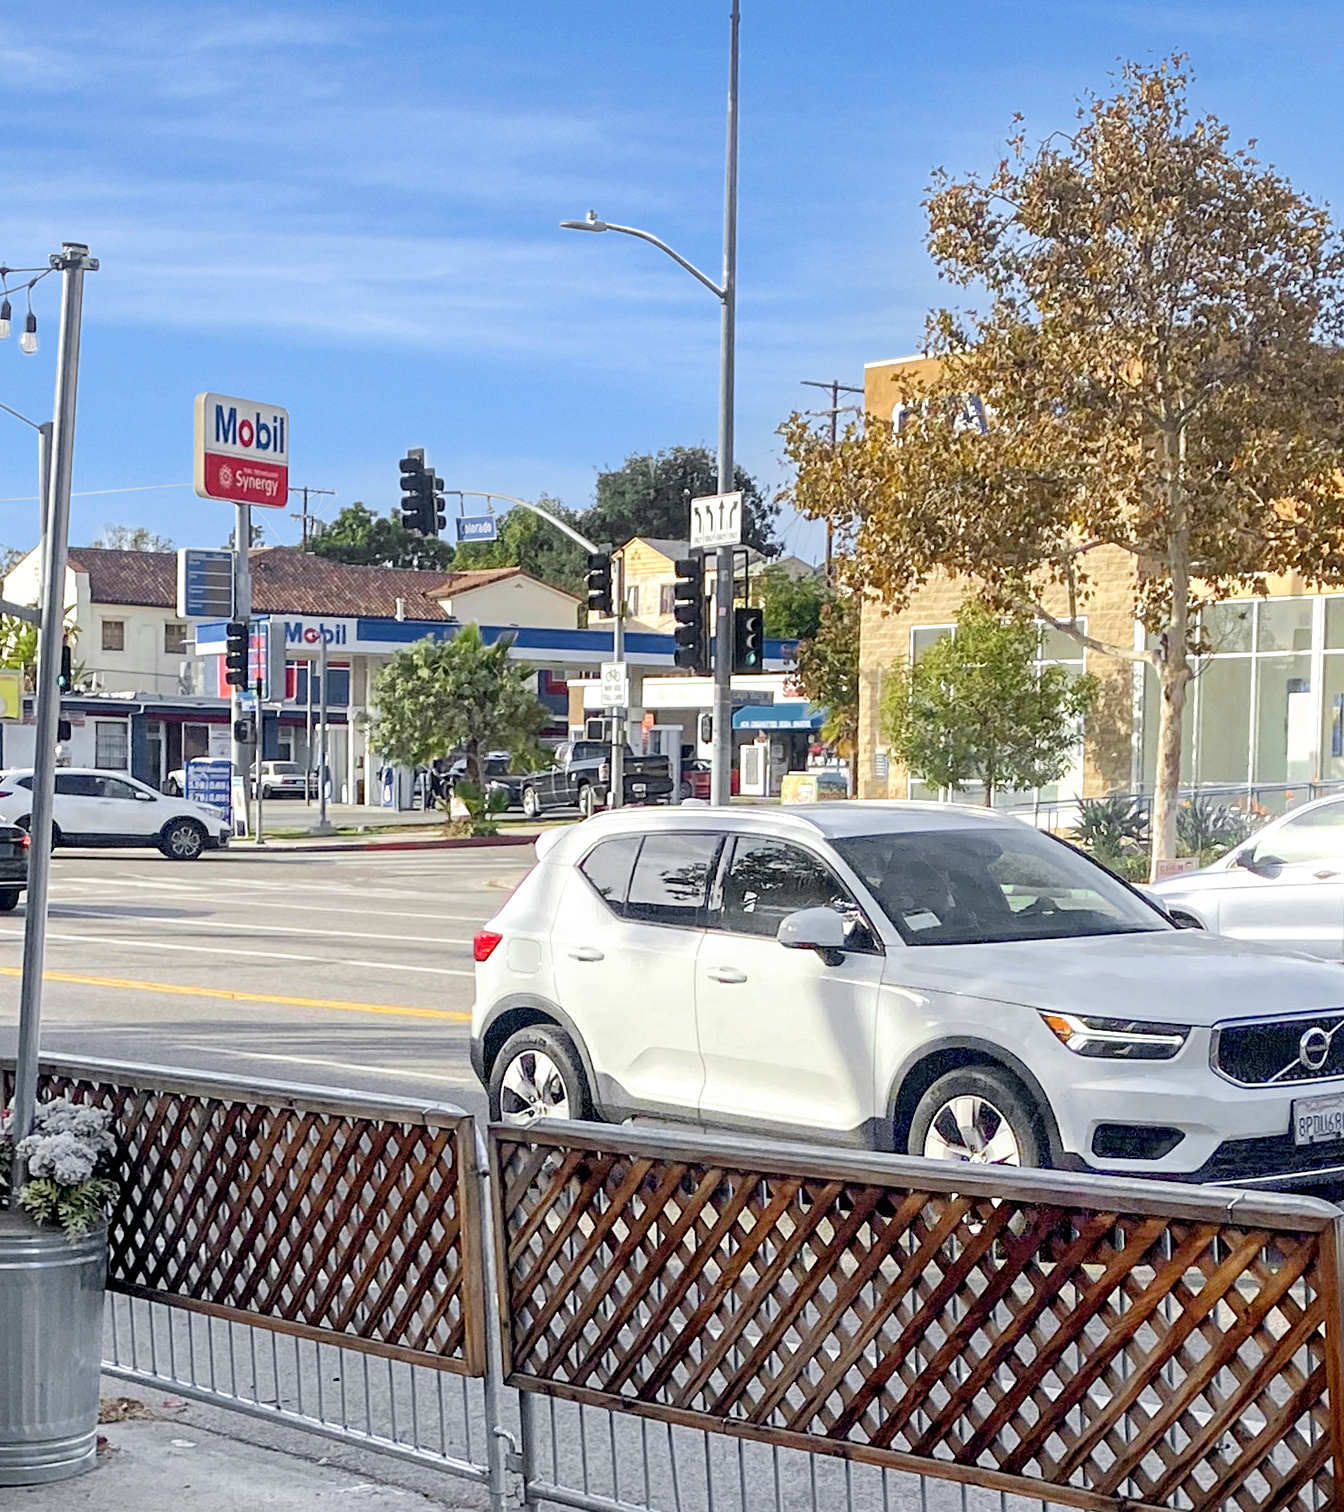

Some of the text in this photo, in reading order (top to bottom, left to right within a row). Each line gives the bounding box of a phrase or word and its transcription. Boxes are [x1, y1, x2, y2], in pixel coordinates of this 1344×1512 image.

[215, 404, 285, 454] Mobil
[235, 470, 279, 497] Synergy
[460, 521, 492, 535] Colorado
[285, 622, 346, 645] Mobil
